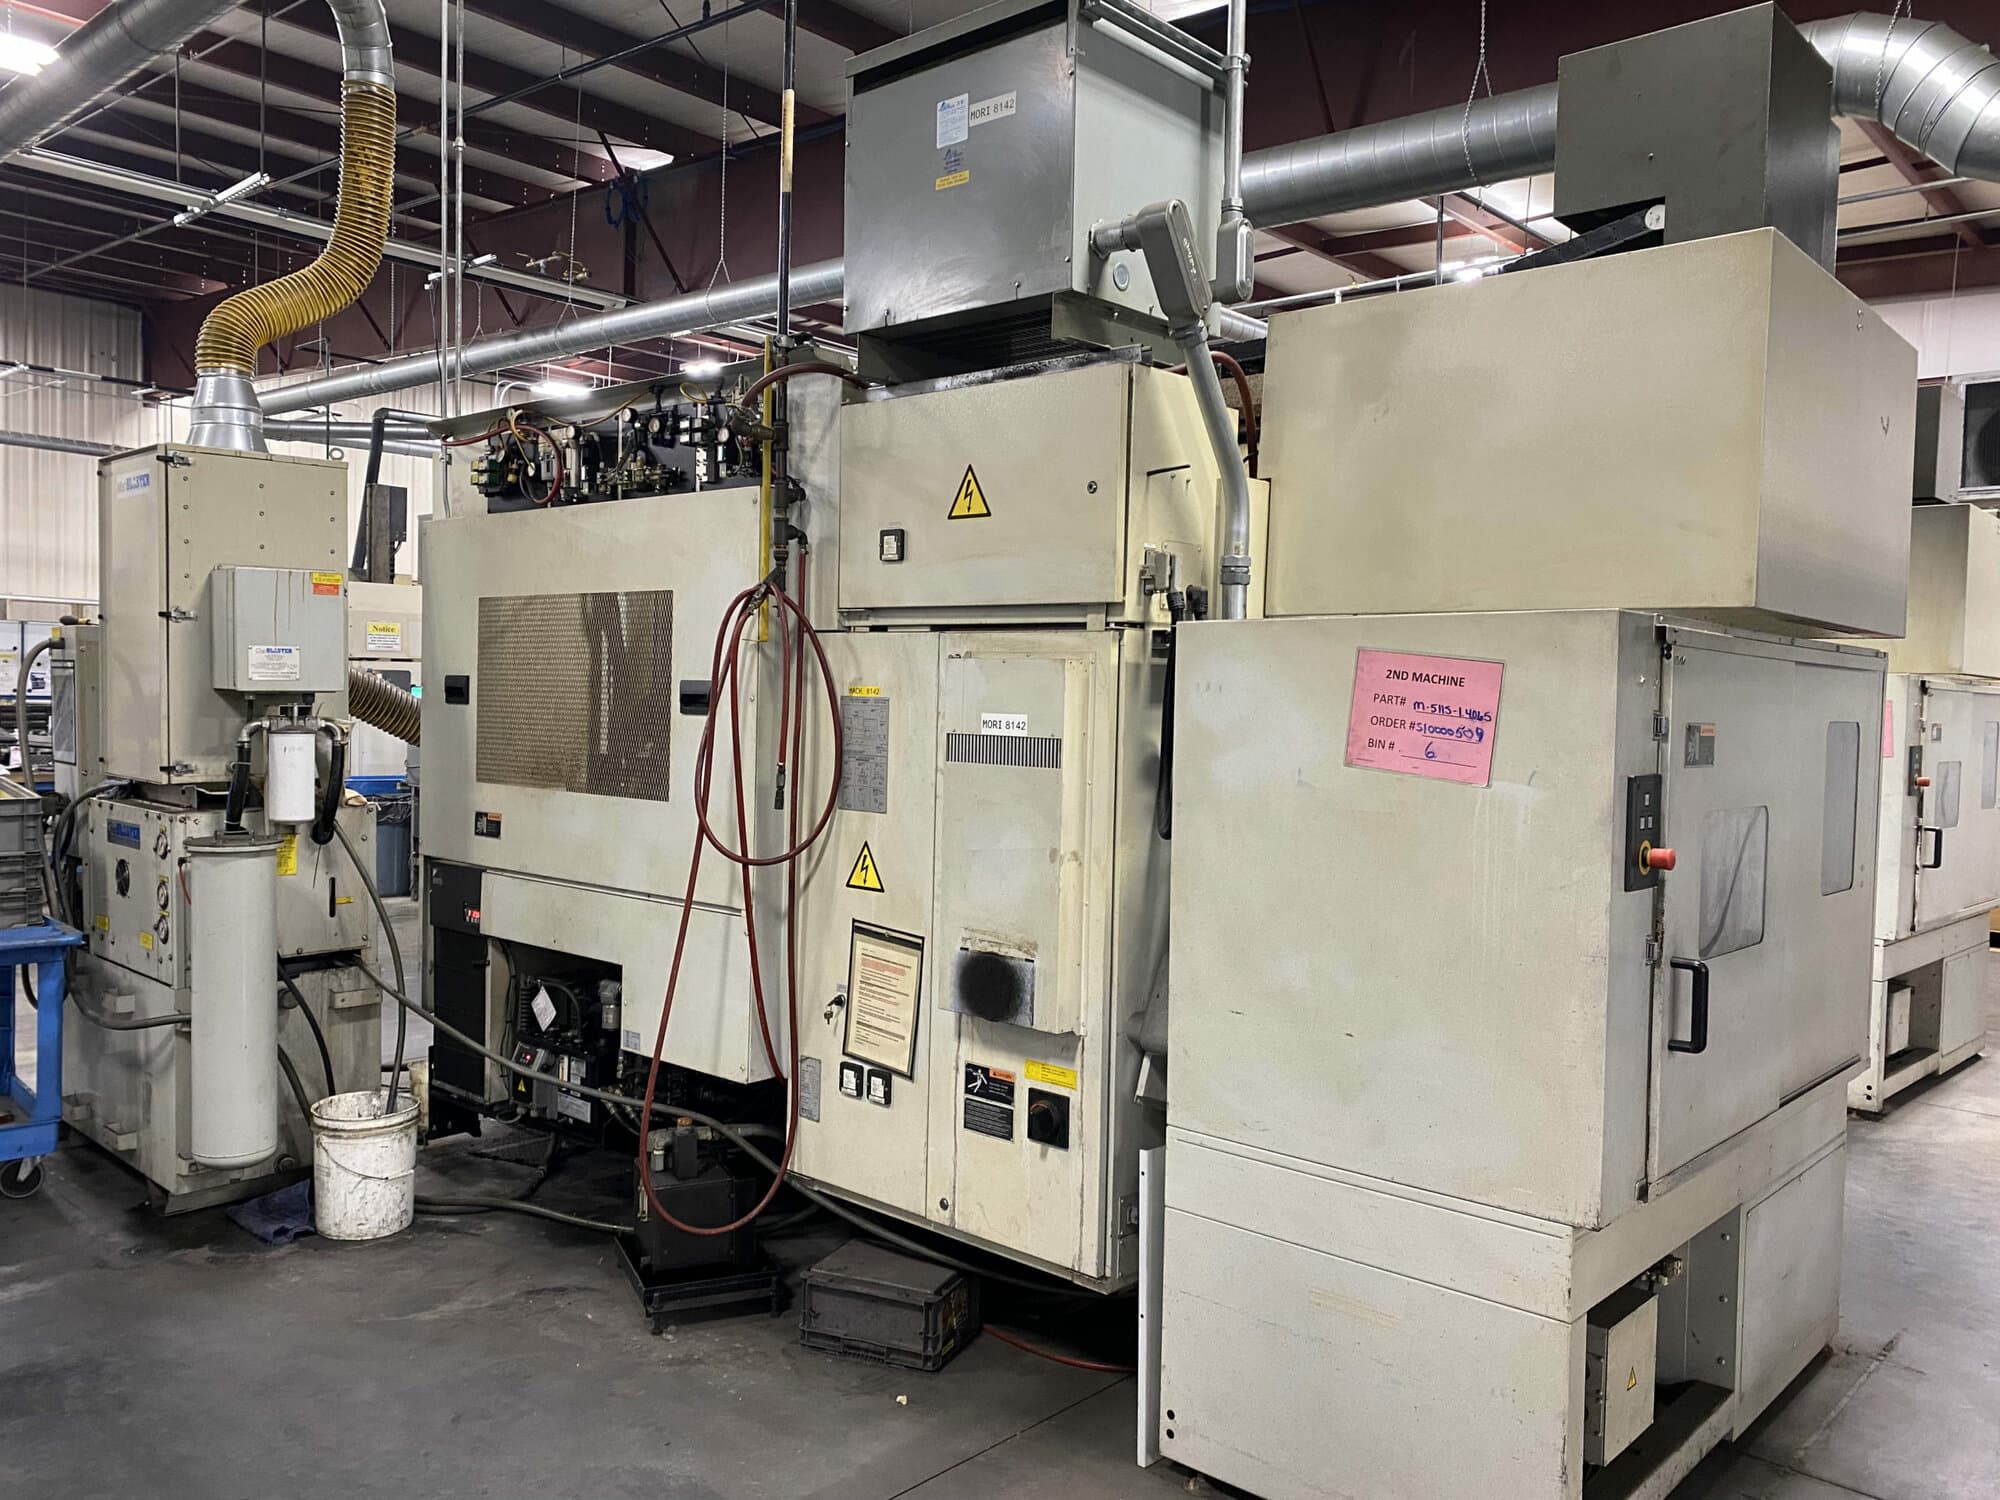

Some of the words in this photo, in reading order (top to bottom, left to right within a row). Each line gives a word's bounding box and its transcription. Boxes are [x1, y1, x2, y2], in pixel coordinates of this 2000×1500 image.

[970, 105, 991, 121] MORI
[993, 98, 1015, 113] 8142
[372, 625, 395, 633] Notice
[1386, 669, 1409, 681] 2ND
[1411, 672, 1466, 687] MACHINE
[1373, 693, 1406, 707] PART#
[982, 719, 1002, 729] MORI
[1005, 720, 1026, 731] 8142
[1370, 715, 1407, 730] ORDER
[1367, 737, 1386, 750] BIN
[1388, 740, 1395, 751] #
[1424, 740, 1436, 759] 6
